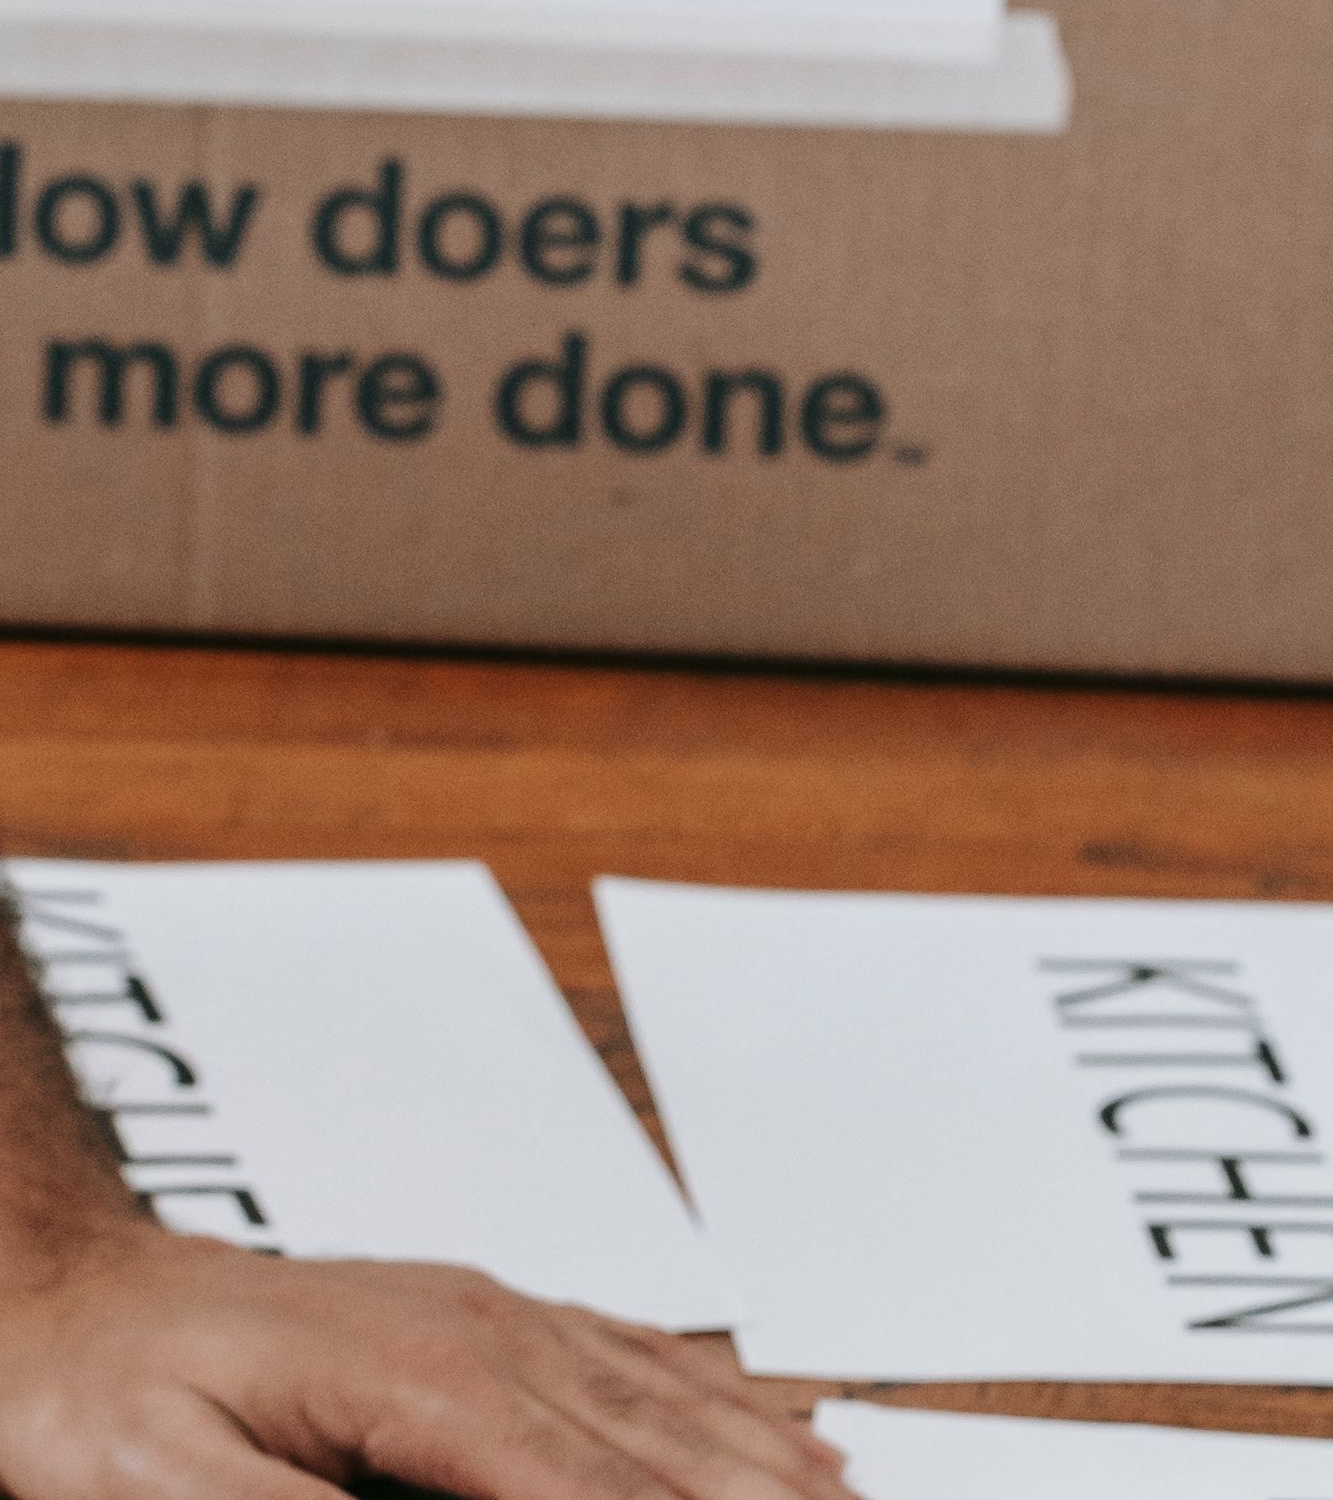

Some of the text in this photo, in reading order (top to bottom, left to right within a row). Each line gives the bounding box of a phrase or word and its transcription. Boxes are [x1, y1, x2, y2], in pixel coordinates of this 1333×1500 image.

[310, 155, 760, 296] doers
[41, 335, 442, 443] more
[1036, 957, 1333, 1334] KITCHEN
